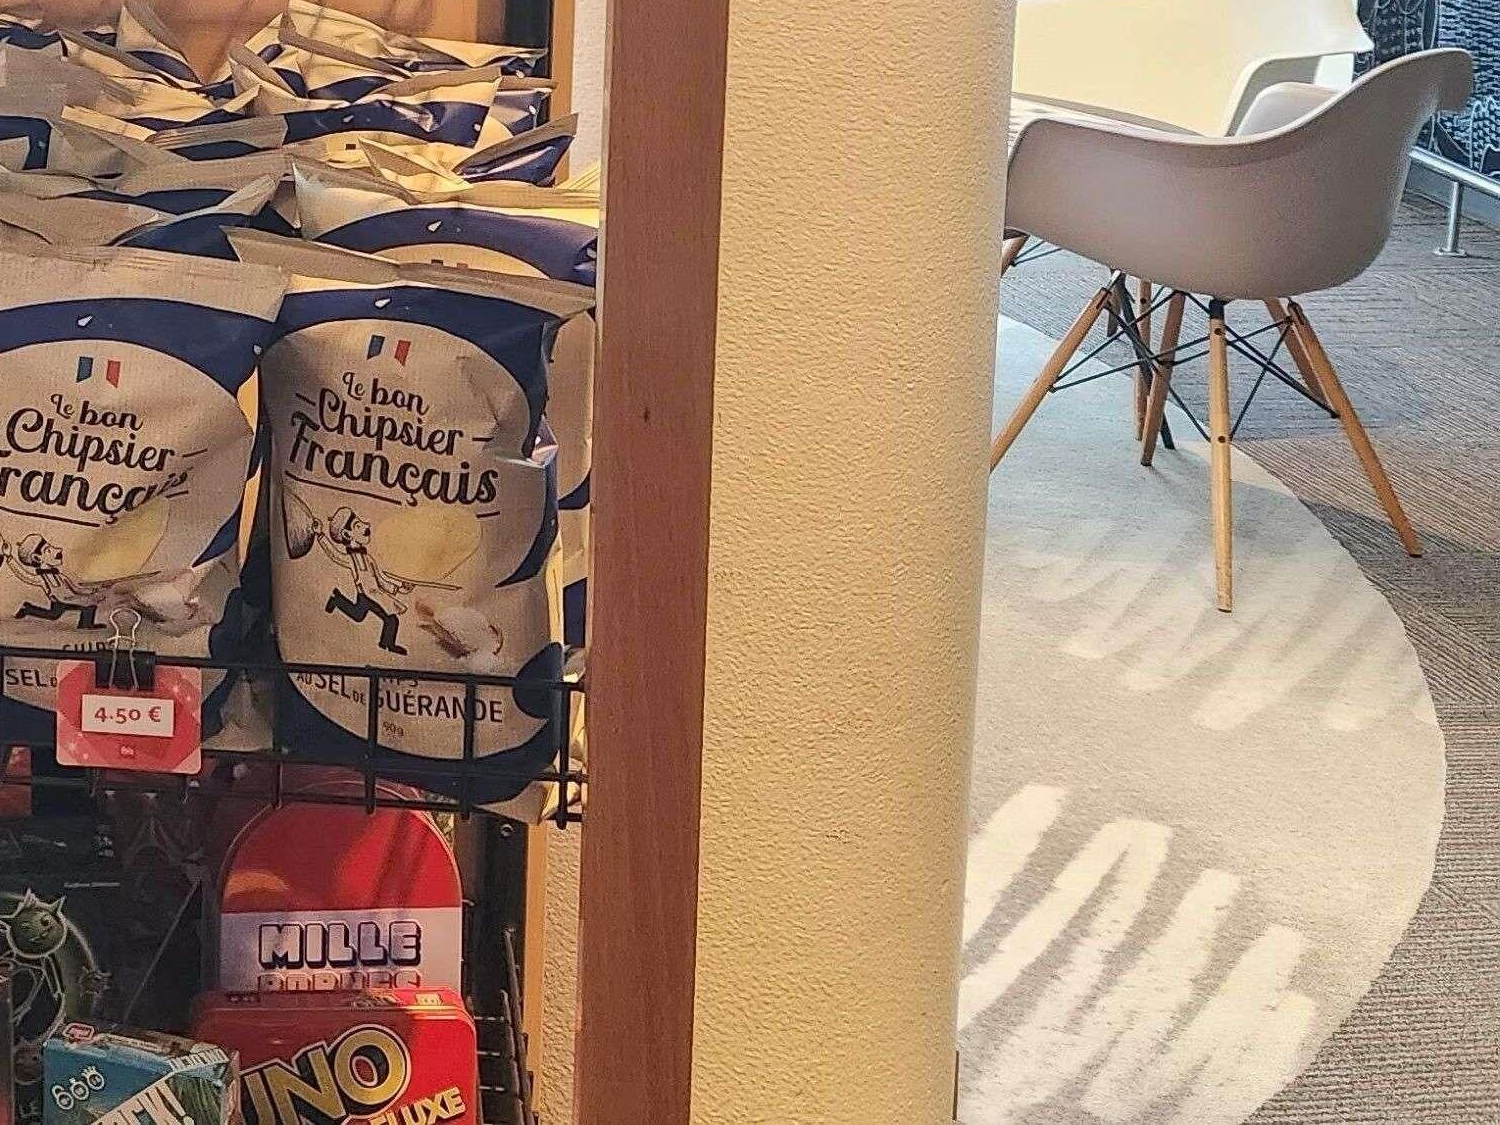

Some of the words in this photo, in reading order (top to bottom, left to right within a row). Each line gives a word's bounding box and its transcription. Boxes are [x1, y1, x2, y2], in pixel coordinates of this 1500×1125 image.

[50, 393, 75, 420] Le
[79, 400, 144, 432] bon
[342, 371, 366, 400] Le
[371, 378, 430, 416] bon
[6, 407, 176, 472] Chipsier
[318, 388, 464, 456] Chipsier
[289, 410, 499, 507] Français
[5, 668, 46, 688] SEL
[94, 706, 141, 725] 4.50
[148, 705, 162, 723] €
[259, 920, 423, 970] MILLE
